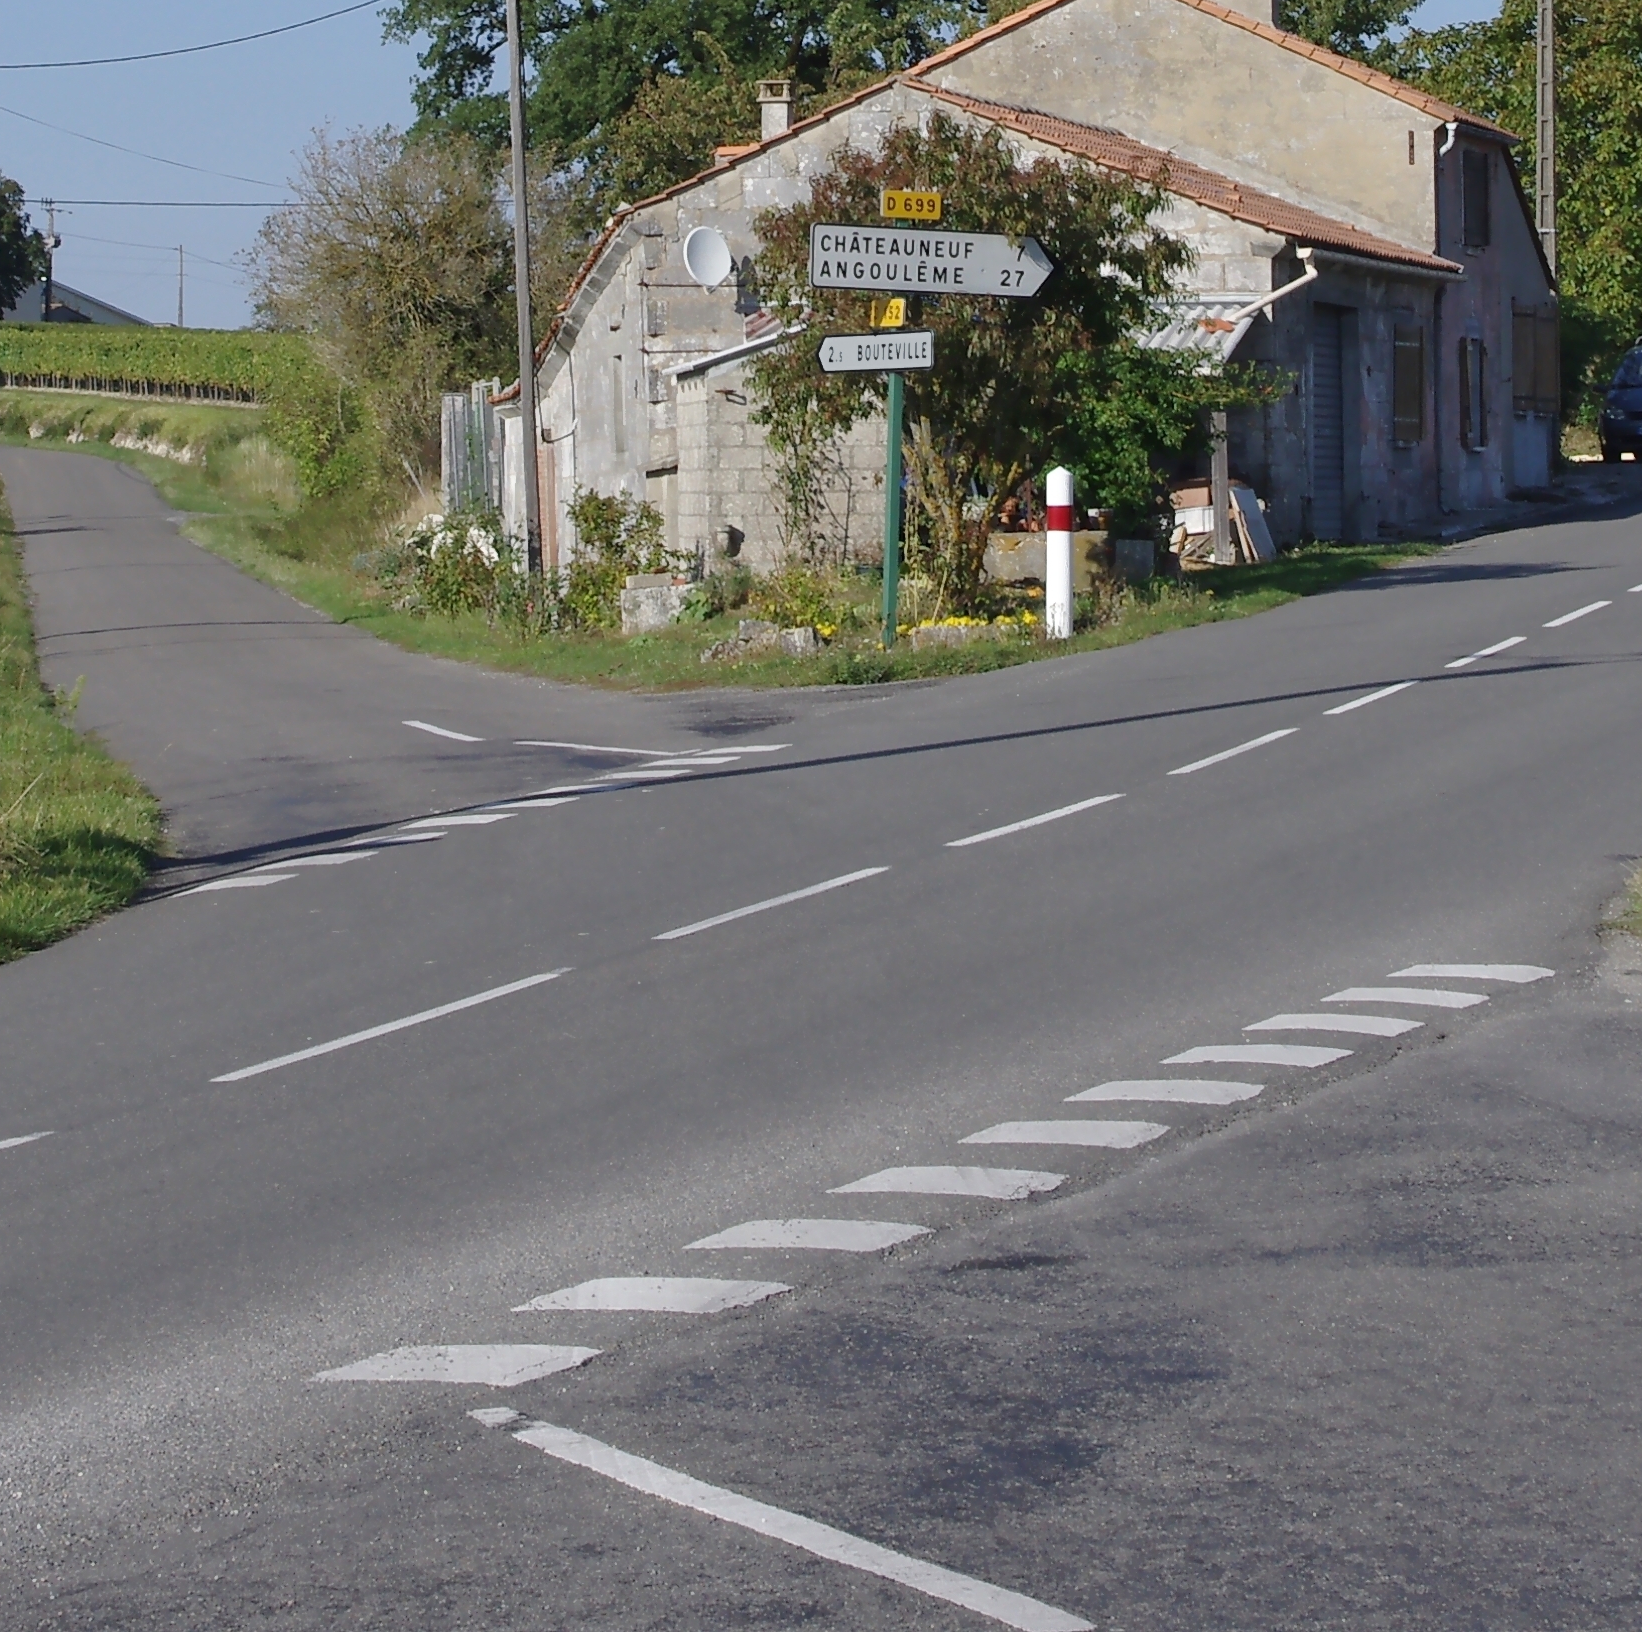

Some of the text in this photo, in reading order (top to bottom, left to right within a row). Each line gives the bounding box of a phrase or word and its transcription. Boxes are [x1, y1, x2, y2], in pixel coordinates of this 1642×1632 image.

[887, 197, 936, 213] D 699
[820, 232, 1025, 262] CHÂTEAUNEUF 7
[820, 260, 1024, 287] ANGOULÊME 27
[858, 342, 927, 361] BOUTEVILLE
